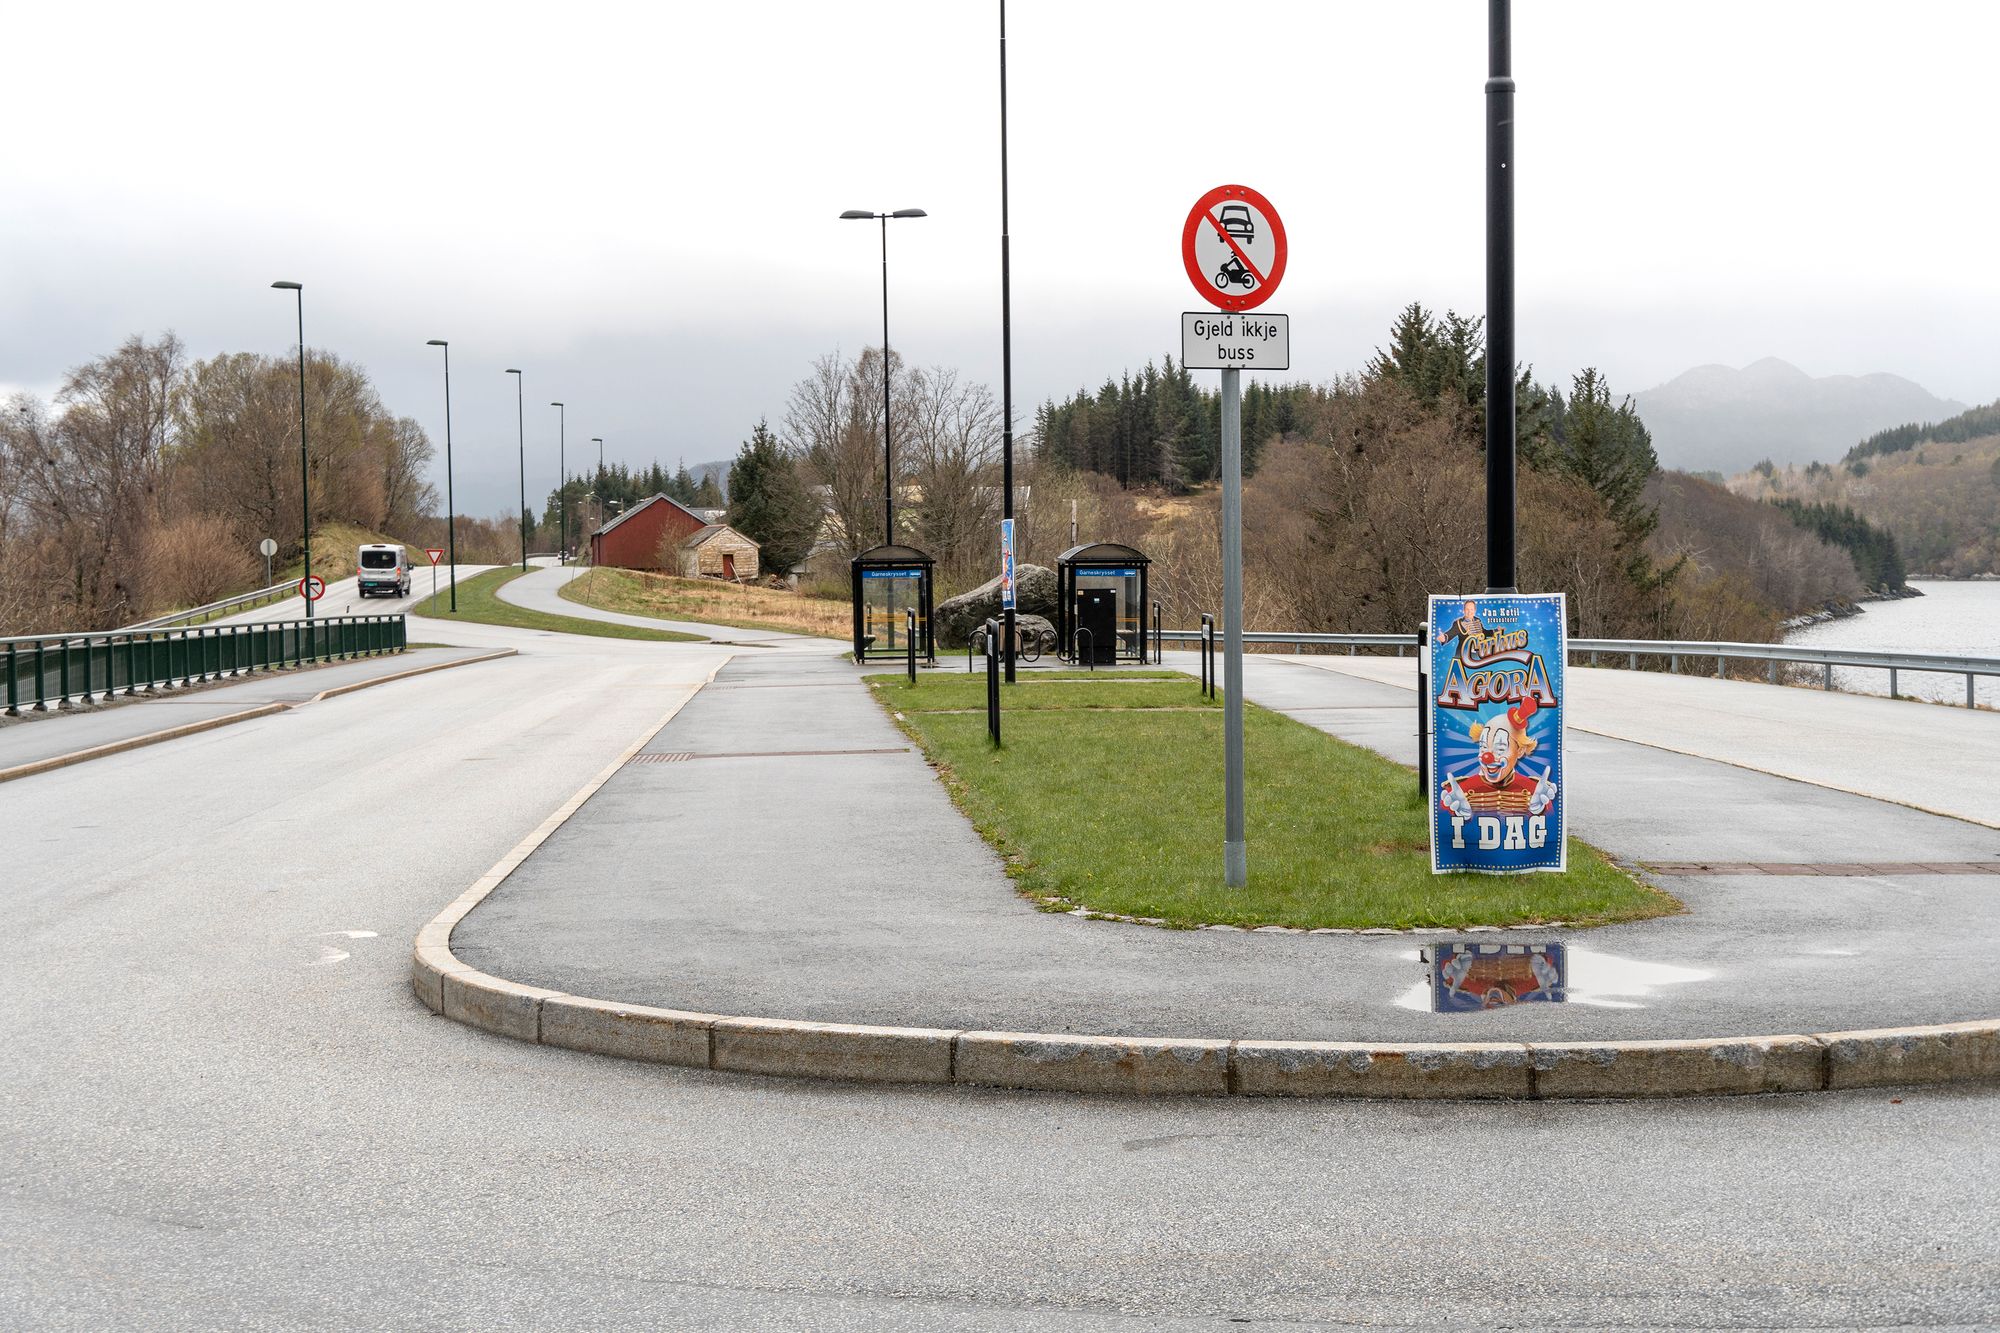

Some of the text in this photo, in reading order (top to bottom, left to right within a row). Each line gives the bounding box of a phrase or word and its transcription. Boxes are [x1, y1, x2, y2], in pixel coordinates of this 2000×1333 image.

[1194, 319, 1277, 341] Gjeld ikkje
[1218, 343, 1255, 360] buss
[1482, 607, 1520, 617] Jan Ketil
[1460, 629, 1530, 669] Cirkus
[1437, 654, 1558, 711] AGORA
[1451, 815, 1548, 850] I DAG
